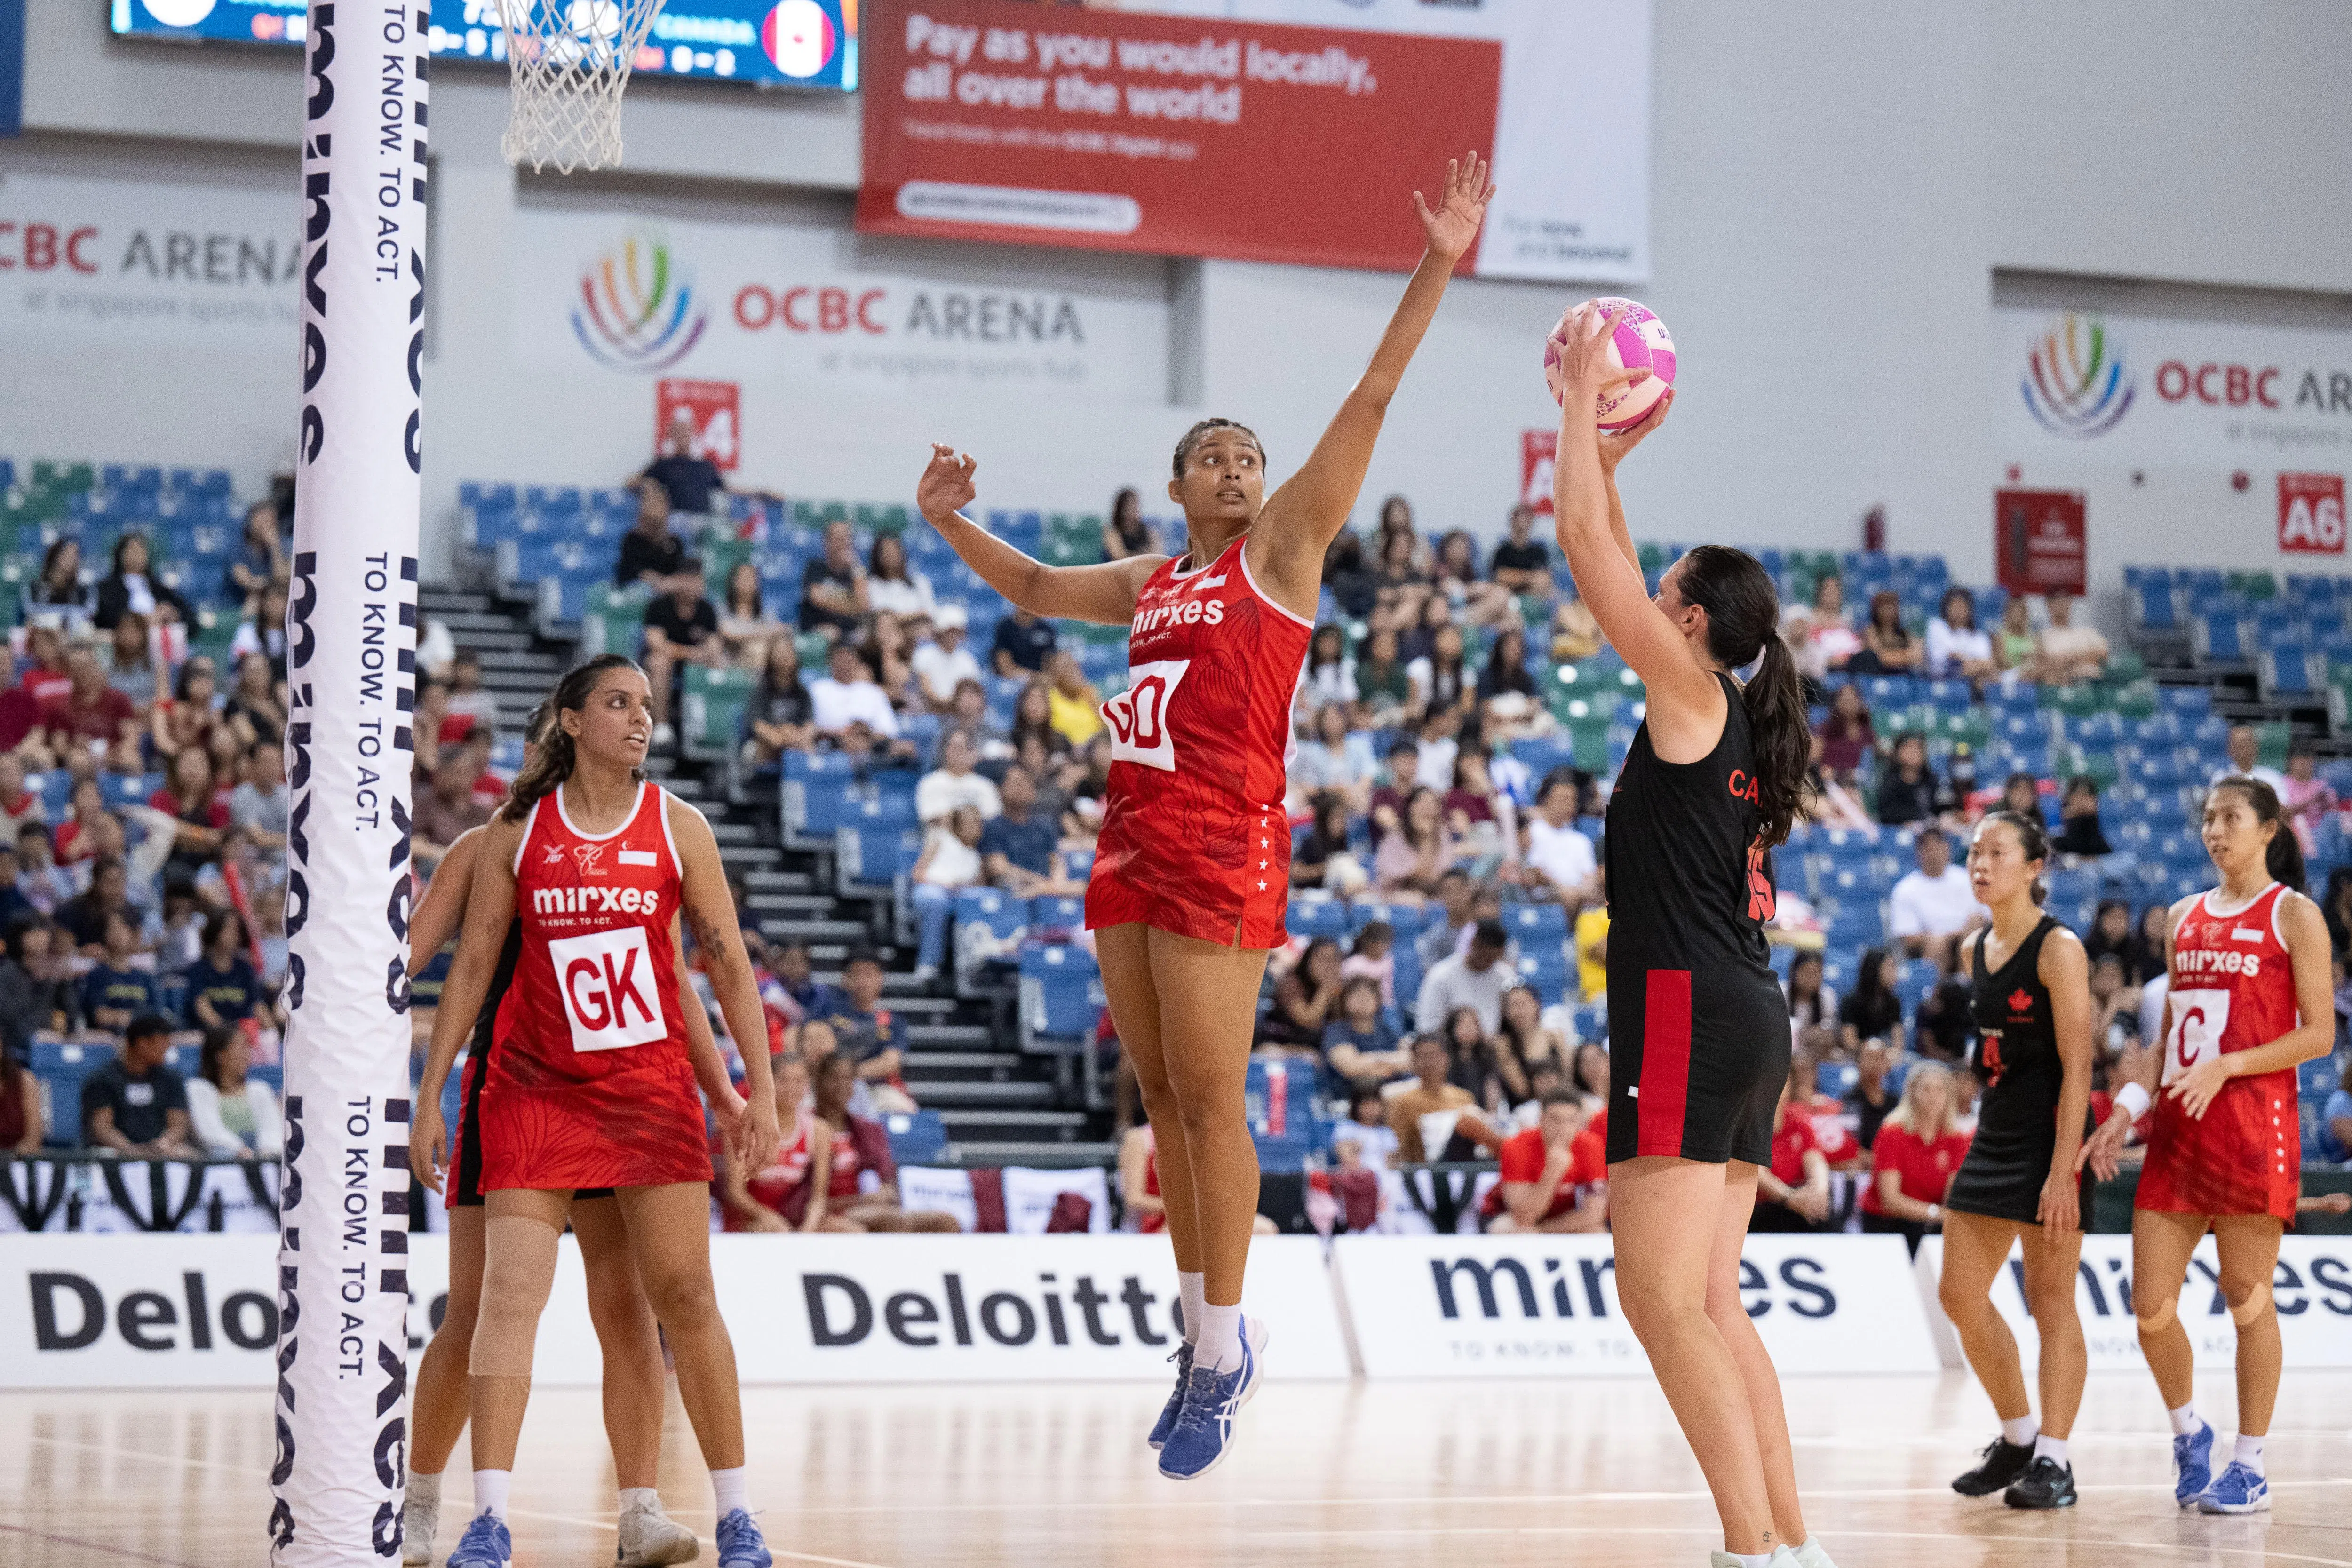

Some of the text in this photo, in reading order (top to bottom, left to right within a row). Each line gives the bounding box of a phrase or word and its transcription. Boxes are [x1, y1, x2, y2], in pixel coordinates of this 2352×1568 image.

[906, 13, 1377, 96] Pay as you would locally,
[904, 62, 1241, 123] all over the world
[376, 4, 406, 283] TO KNOW. TO ACT.
[733, 286, 1086, 342] OCBC ARENA
[2156, 360, 2279, 409] OCBC
[2284, 497, 2343, 547] A6
[1130, 638, 1146, 649] NOW.
[1155, 632, 1172, 641] ACT.
[355, 552, 388, 832] TO KNOW. TO ACT.
[1729, 769, 1764, 809] CA
[533, 886, 659, 915] mirxes
[548, 918, 576, 927] KNOW.
[580, 917, 591, 926] TO
[594, 917, 613, 926] ACT.
[566, 947, 657, 1032] GK
[2178, 1006, 2205, 1067] C
[338, 1095, 371, 1382] TO KNOW. TO ACT.
[1429, 1255, 1838, 1319] mires
